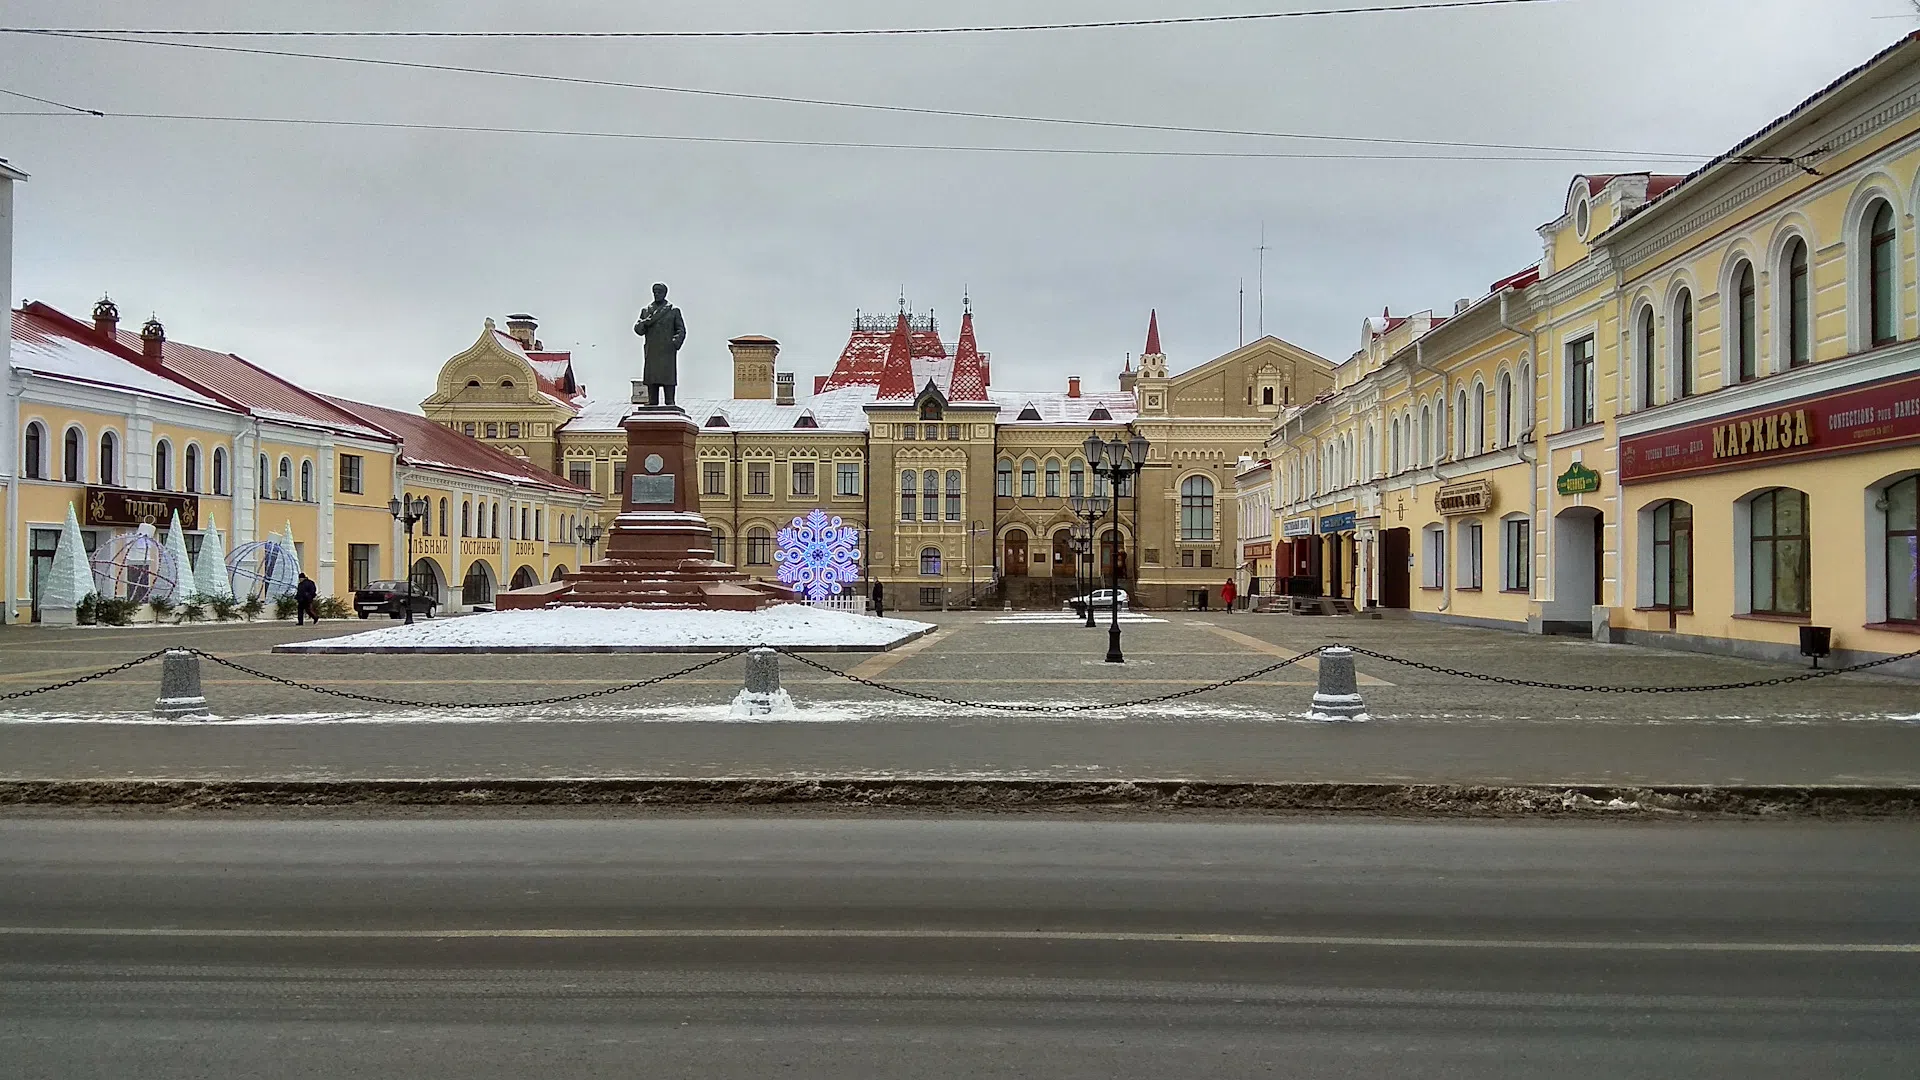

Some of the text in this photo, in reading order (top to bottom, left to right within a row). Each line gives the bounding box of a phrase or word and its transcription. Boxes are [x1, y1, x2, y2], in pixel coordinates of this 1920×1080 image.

[1828, 407, 1875, 430] CONFECTIONS
[1894, 398, 1920, 418] DAMES
[1712, 409, 1809, 459] МАРКИЗА
[125, 499, 168, 517] ТРАКТИРЪ
[460, 540, 501, 555] ГОСТИННЫЙ
[516, 542, 535, 556] ДВОРЪ
